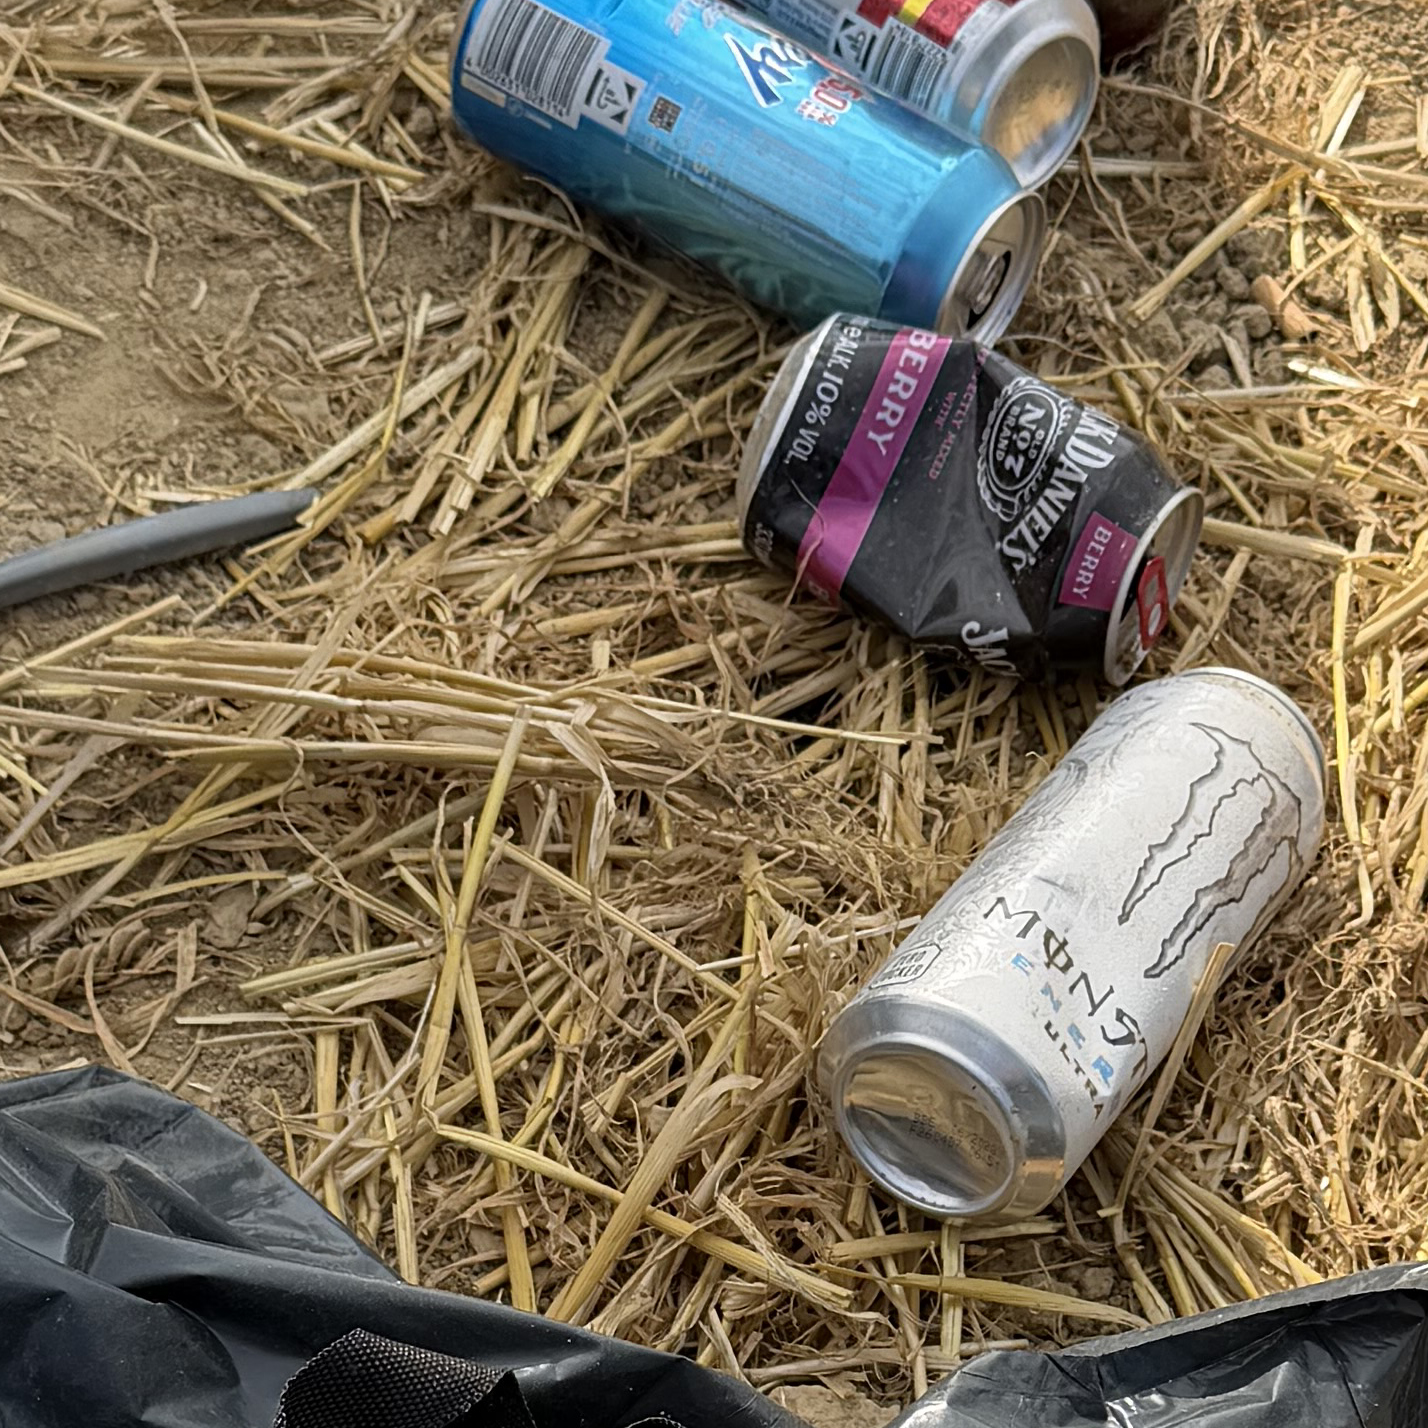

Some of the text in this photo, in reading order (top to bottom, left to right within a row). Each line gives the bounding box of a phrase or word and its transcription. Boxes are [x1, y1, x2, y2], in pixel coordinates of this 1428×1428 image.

[826, 336, 859, 371] ALK.
[805, 371, 844, 426] 10%
[866, 329, 938, 457] BERRY
[782, 426, 820, 465] VOL.
[928, 431, 957, 481] MIXED
[995, 405, 1022, 462] BRAND
[1027, 428, 1046, 461] OLD
[1001, 435, 1117, 573] DANIEL'S
[1072, 525, 1113, 601] BERRY
[1043, 1019, 1105, 1121] ULTRA
